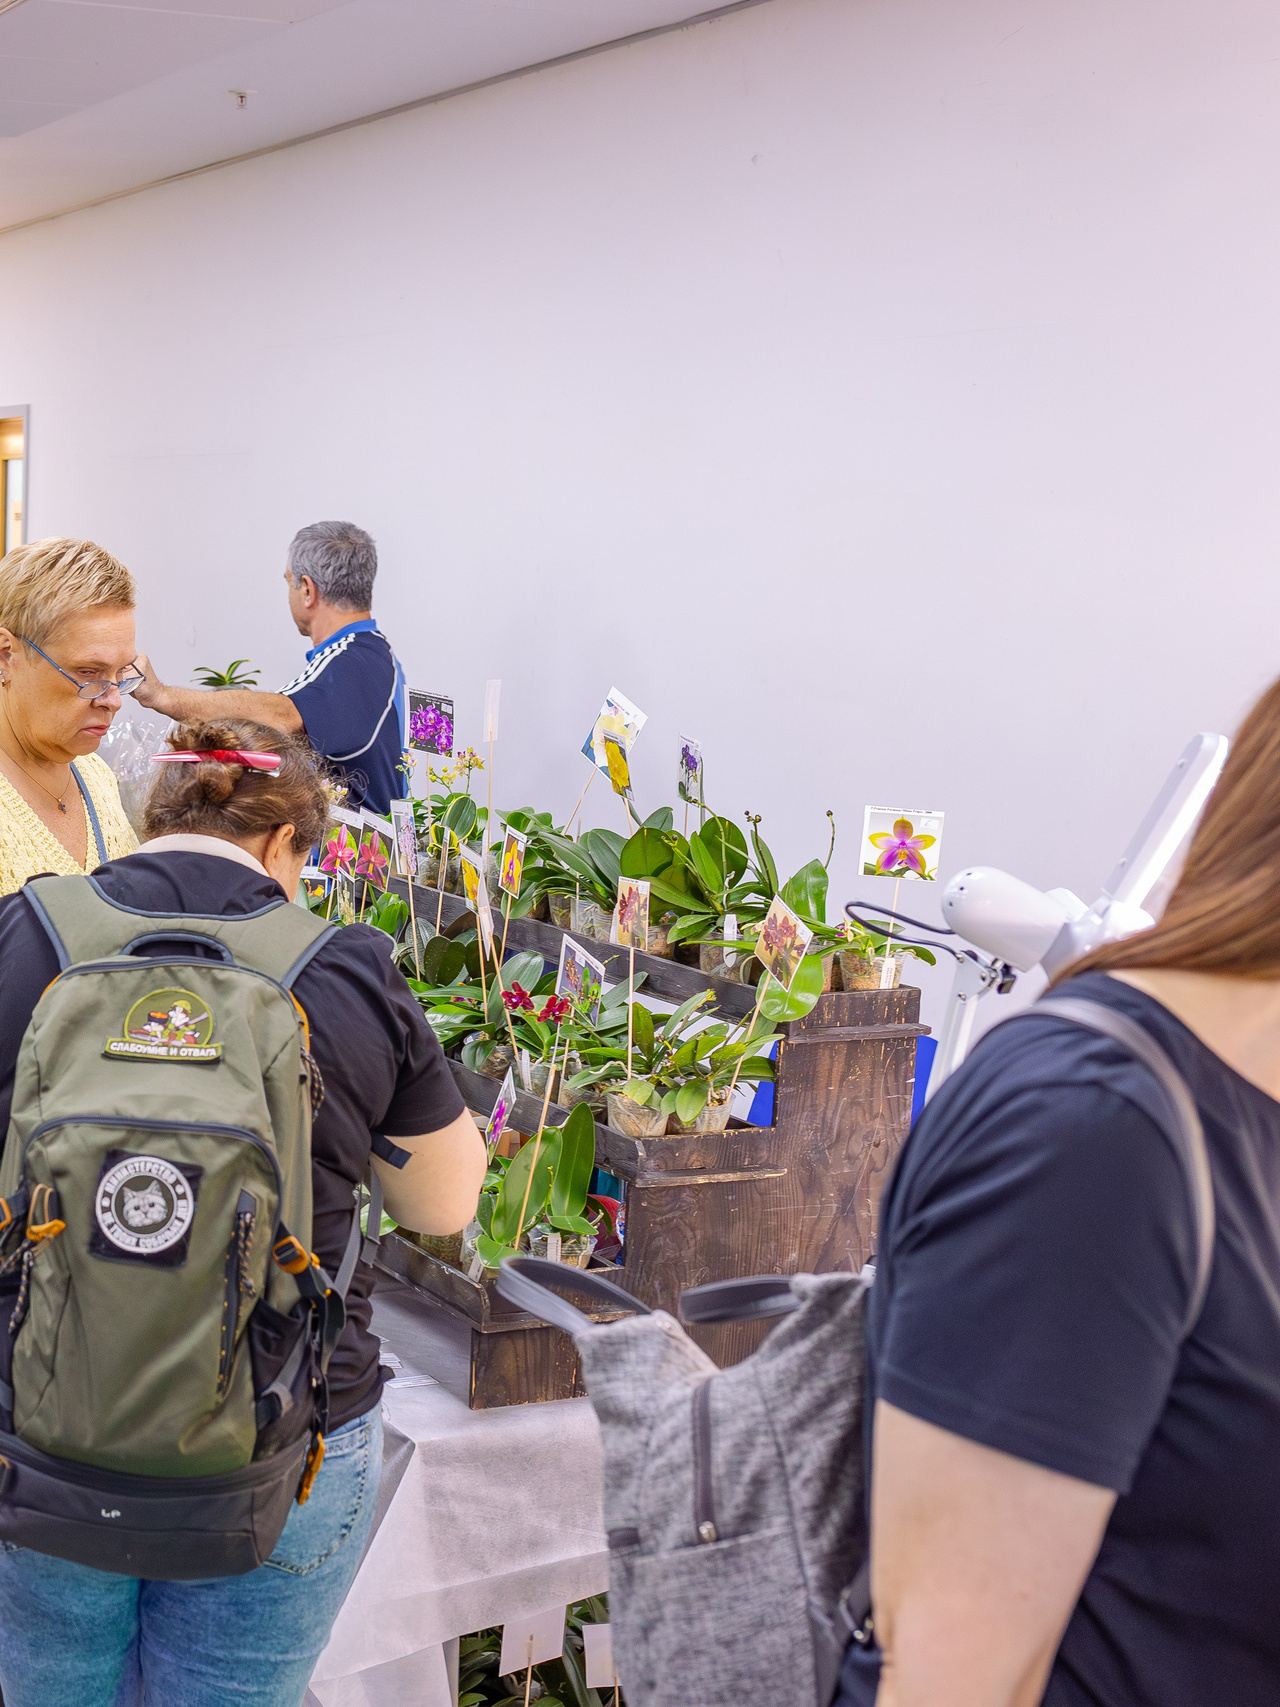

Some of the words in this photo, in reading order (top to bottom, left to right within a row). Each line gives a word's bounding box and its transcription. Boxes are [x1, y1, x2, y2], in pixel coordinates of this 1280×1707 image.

[109, 1041, 168, 1057] СЛАБОУМИЕ
[169, 1048, 178, 1057] И
[179, 1048, 217, 1057] ОТВАГА
